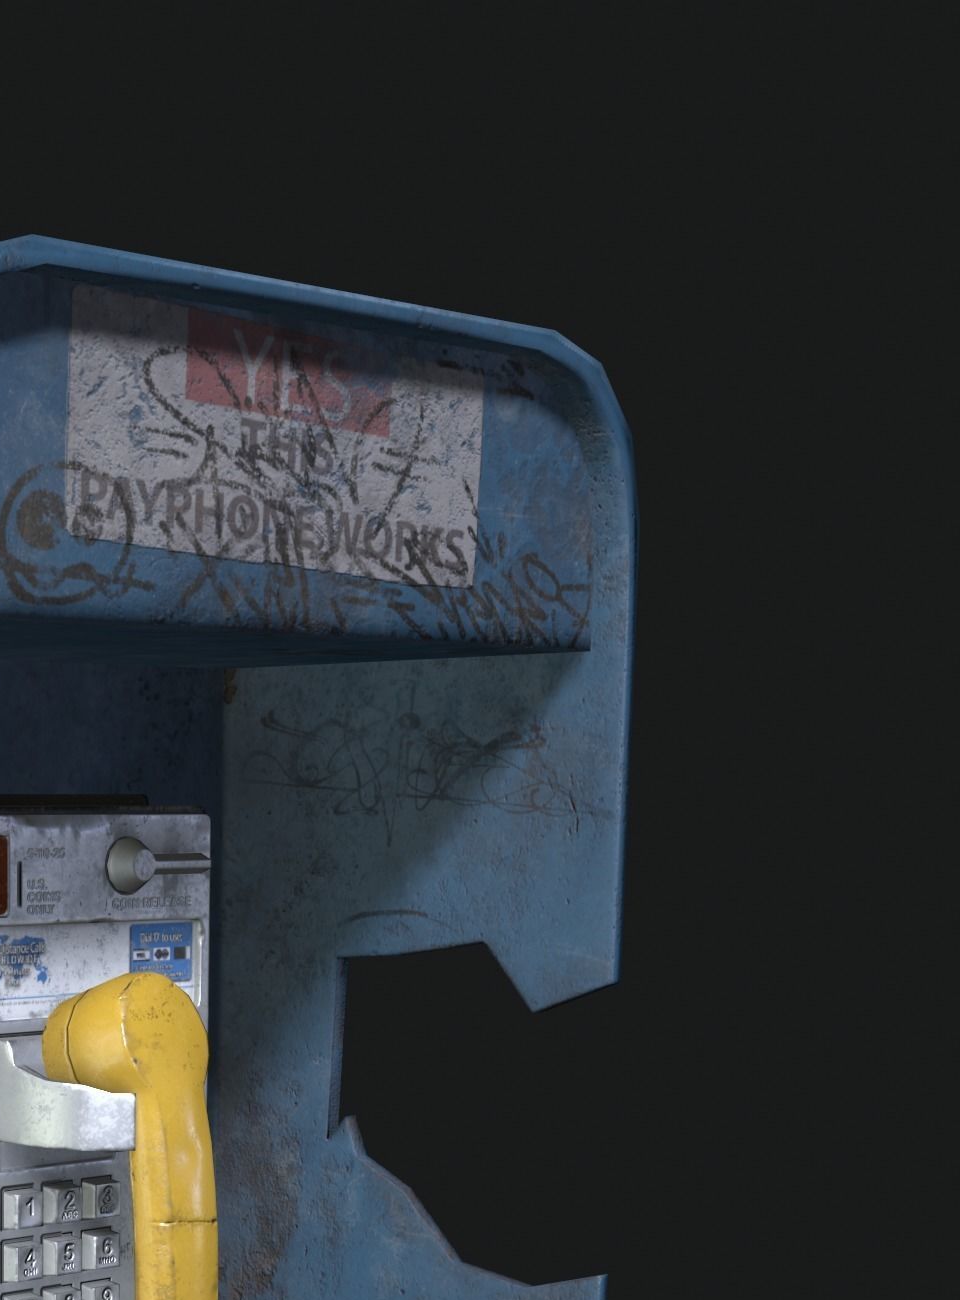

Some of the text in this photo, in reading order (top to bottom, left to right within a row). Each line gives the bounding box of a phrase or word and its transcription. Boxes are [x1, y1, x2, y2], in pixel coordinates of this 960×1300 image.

[233, 327, 352, 424] YES
[241, 416, 335, 476] THIS
[327, 509, 469, 577] WORKS
[25, 1196, 35, 1217] 1
[64, 1189, 76, 1211] 2
[63, 1242, 76, 1261] 5
[102, 1237, 115, 1256] 6
[25, 1248, 37, 1268] 4
